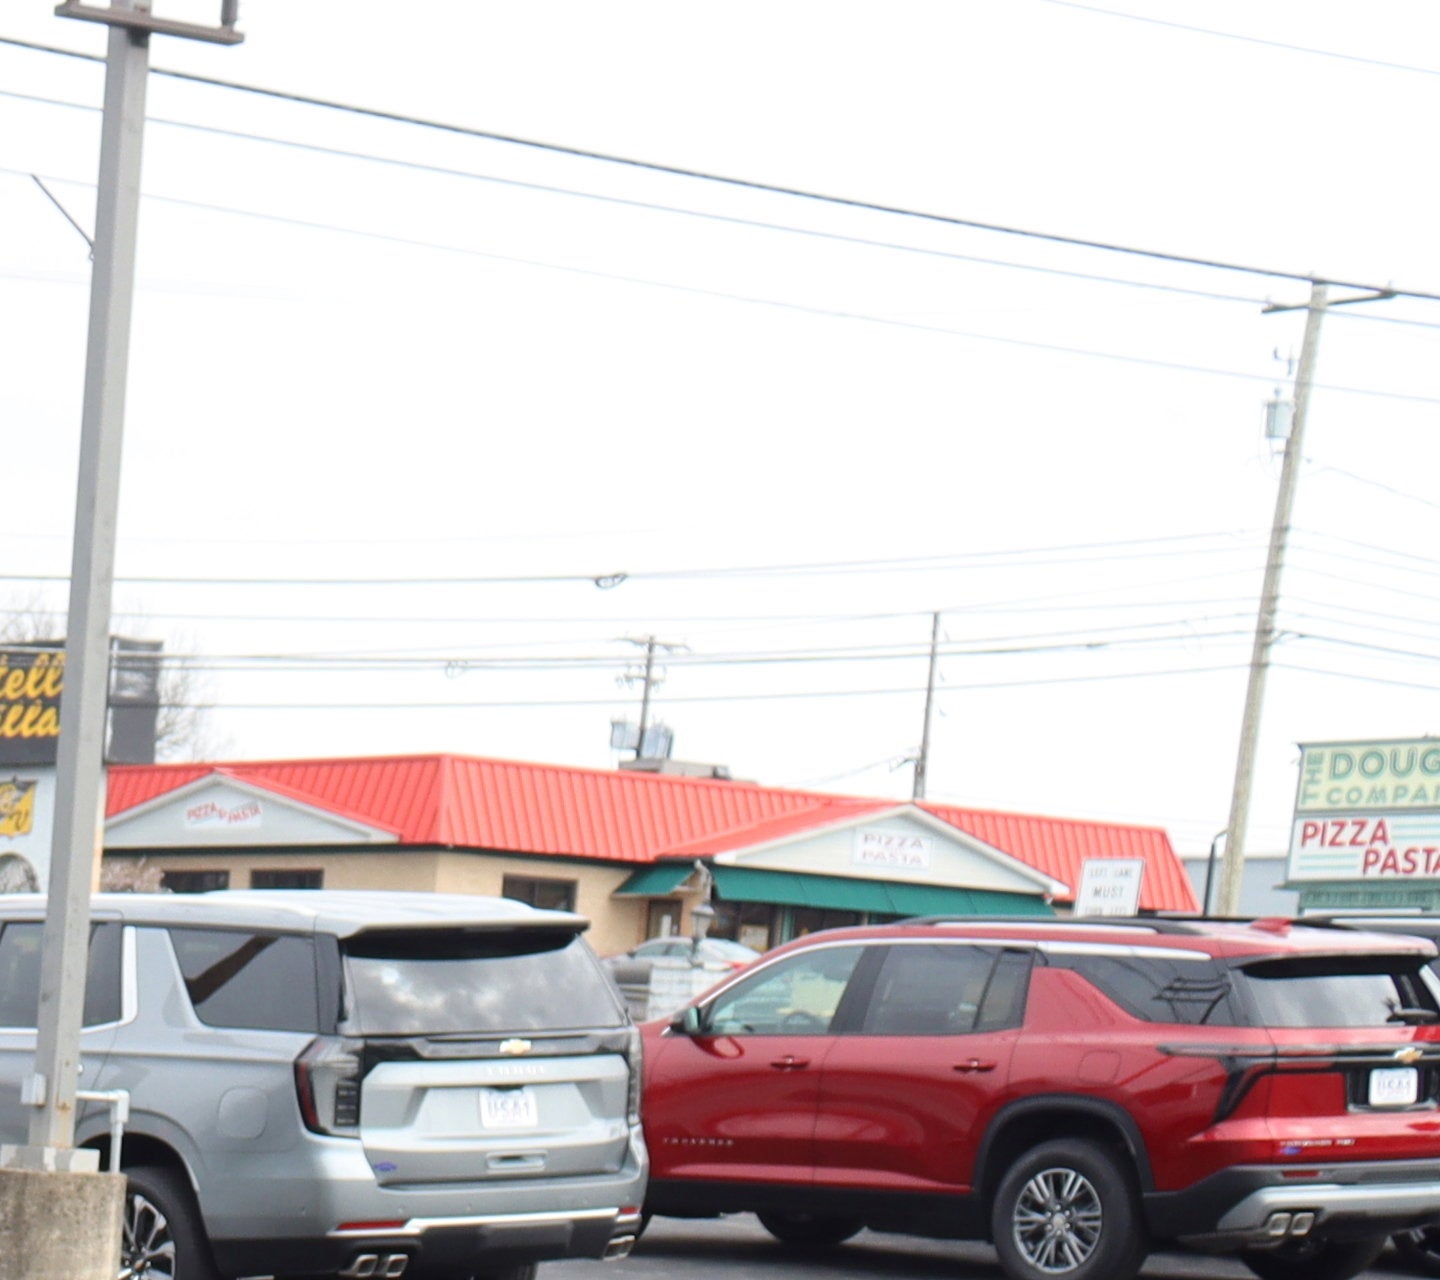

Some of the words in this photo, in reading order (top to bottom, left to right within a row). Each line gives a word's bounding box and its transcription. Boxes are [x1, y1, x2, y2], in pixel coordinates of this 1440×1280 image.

[1301, 752, 1325, 806] THE
[1326, 784, 1440, 804] COMPA
[864, 834, 924, 848] PIZZA
[1301, 818, 1389, 848] PIZZA
[863, 850, 924, 864] PASTA
[1093, 886, 1125, 898] MUST
